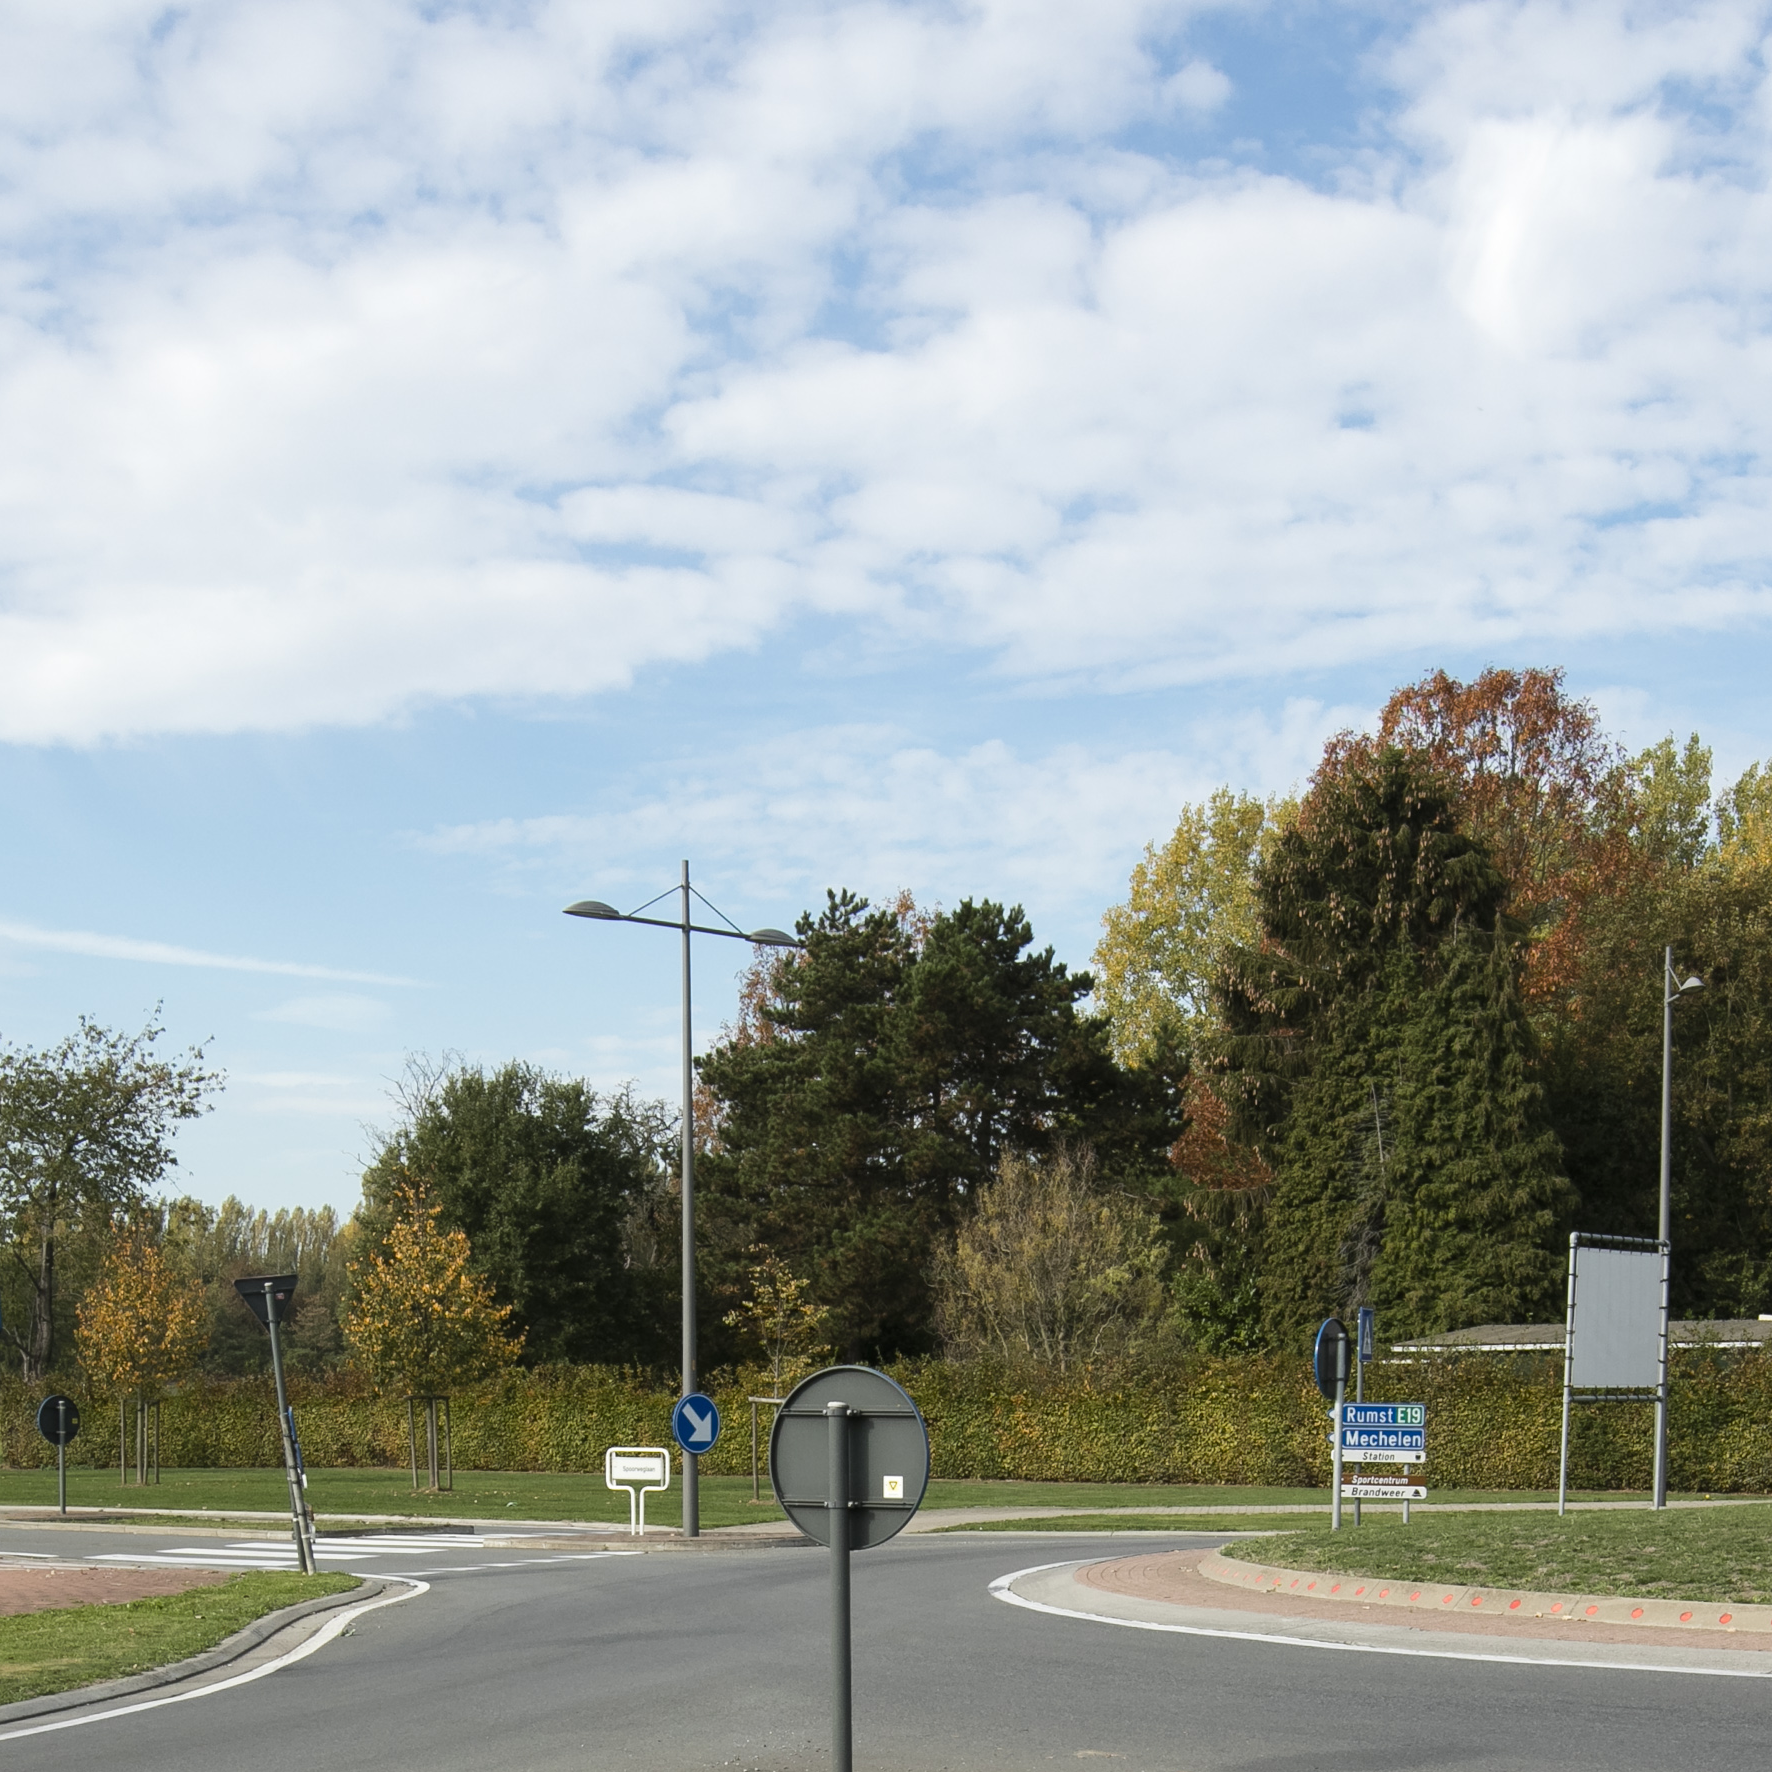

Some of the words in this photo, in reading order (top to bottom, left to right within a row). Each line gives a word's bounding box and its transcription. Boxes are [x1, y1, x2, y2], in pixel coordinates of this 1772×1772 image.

[1346, 1407, 1394, 1423] Rumst
[1397, 1407, 1421, 1424] E19
[1345, 1430, 1421, 1447] Mechelen
[1362, 1452, 1395, 1461] Station
[622, 1465, 655, 1473] Spoorweglaan
[1351, 1475, 1409, 1485] Sportcentrum
[1351, 1487, 1406, 1497] Brandweer
